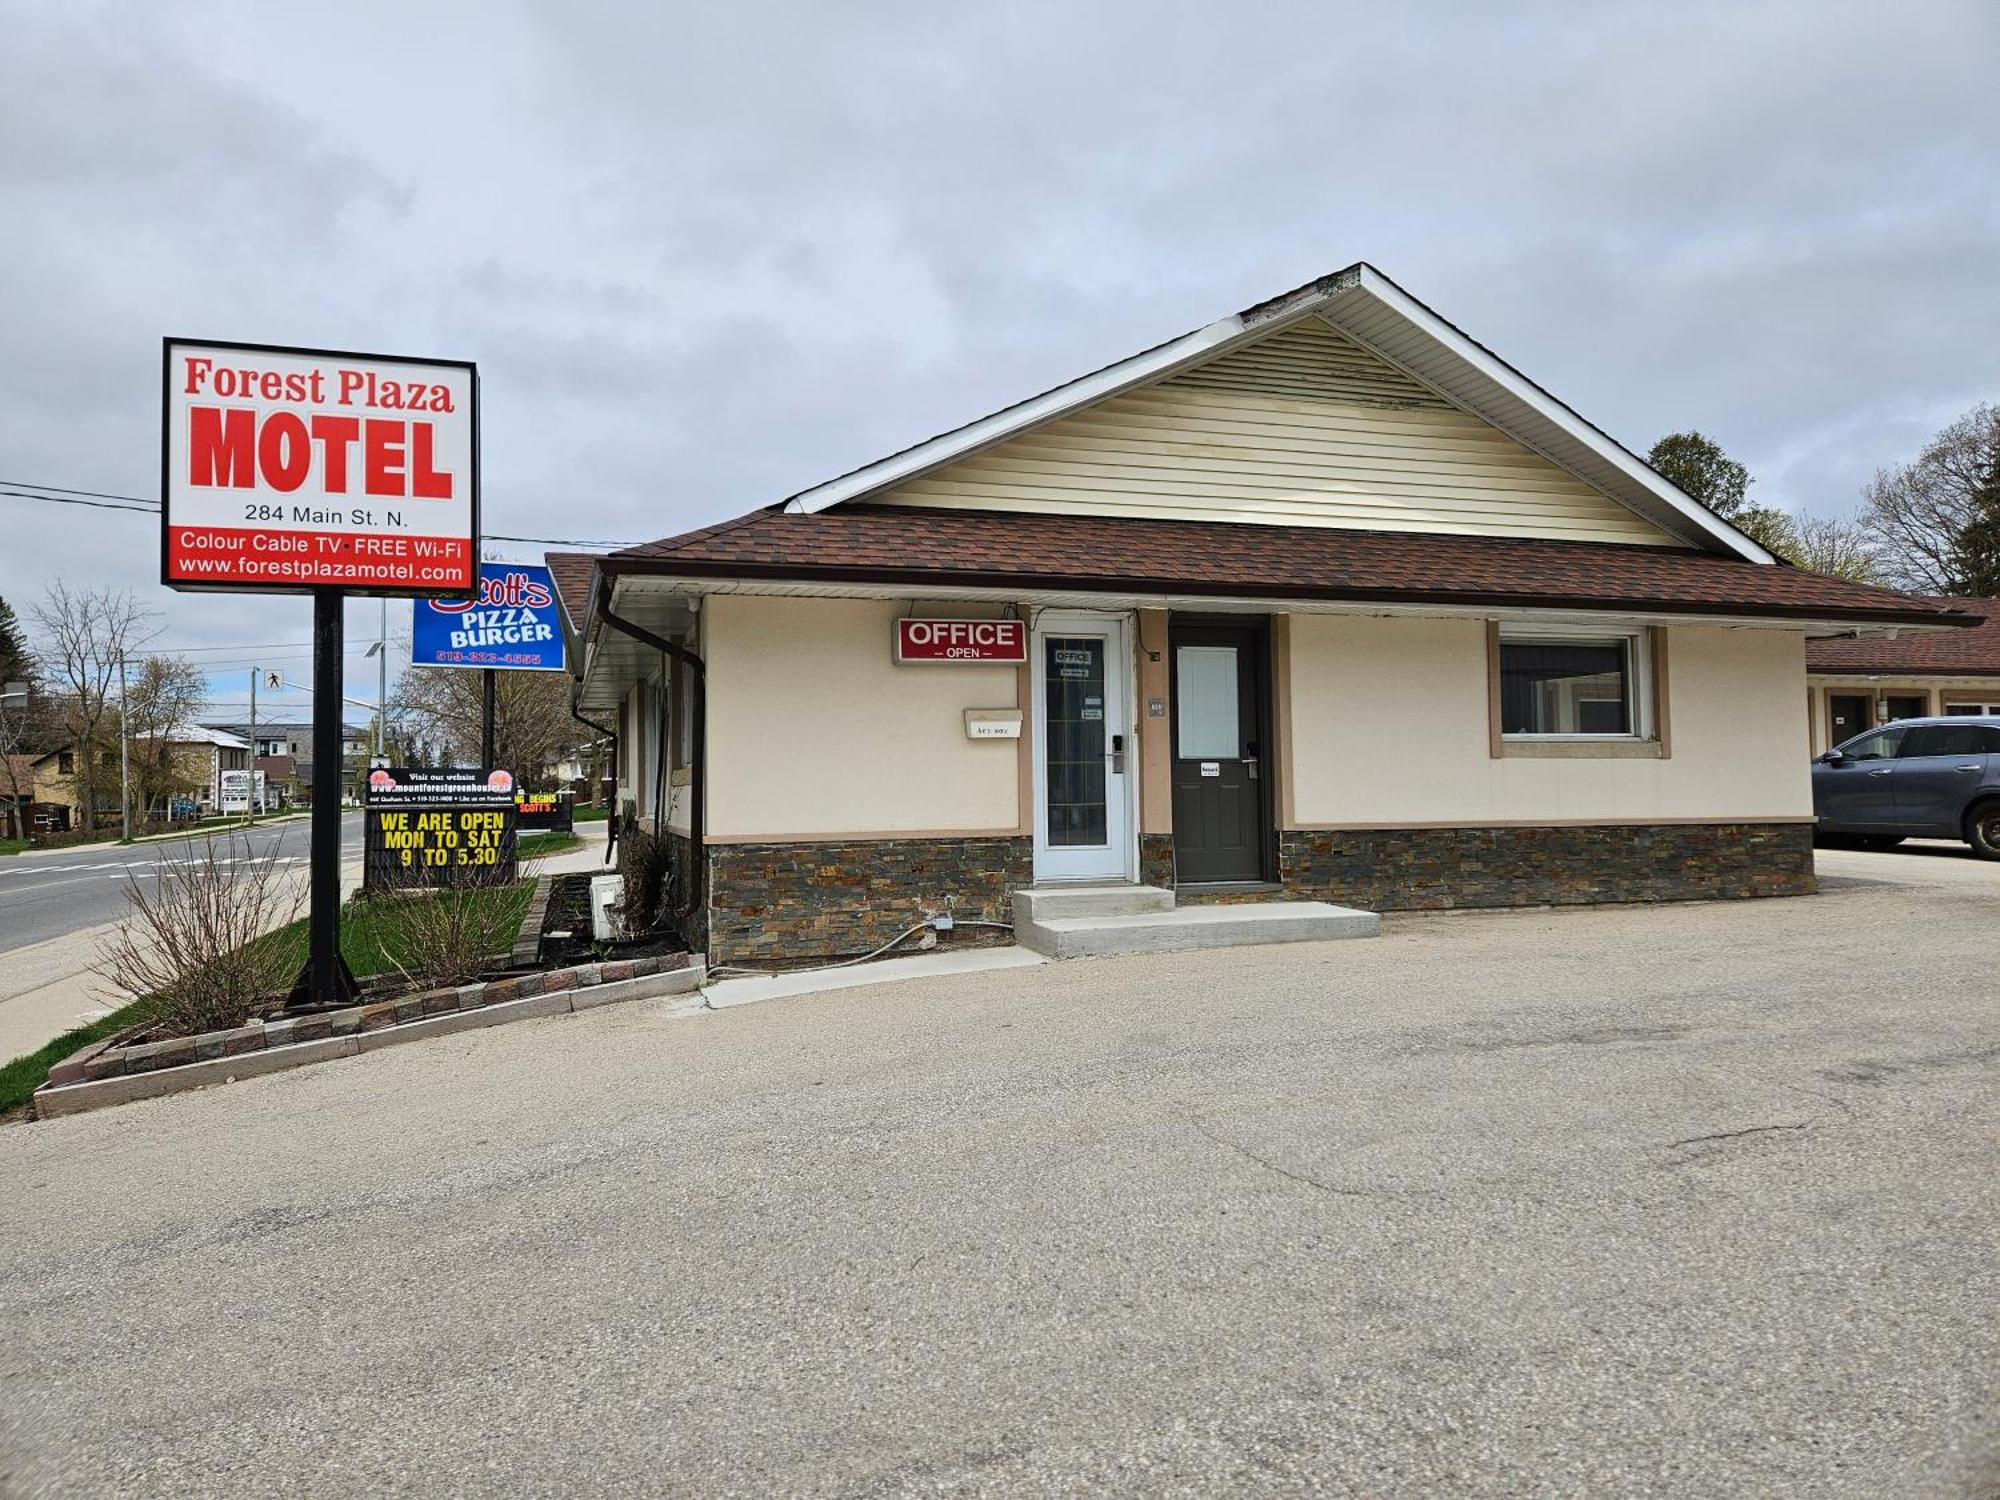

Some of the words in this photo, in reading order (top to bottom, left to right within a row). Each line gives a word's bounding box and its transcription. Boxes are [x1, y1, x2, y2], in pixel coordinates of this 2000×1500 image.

[184, 357, 325, 404] Forest
[337, 369, 455, 414] Plaza
[189, 406, 453, 500] MOTEL
[244, 504, 284, 522] 284
[293, 508, 343, 525] Main
[351, 510, 378, 527] St.
[387, 511, 409, 527] N.
[180, 532, 246, 551] Colour
[252, 534, 309, 553] Cable
[315, 537, 342, 554] TV
[354, 539, 407, 557] FREE
[414, 541, 462, 558] Wi-Fi
[179, 557, 462, 581] www.forestplazamotel.com
[461, 607, 538, 630] PIZZA
[450, 623, 553, 649] BURGER
[908, 622, 1015, 646] OFFICE
[946, 647, 980, 658] OPEN
[1057, 652, 1089, 662] OFFICE
[408, 772, 428, 781] Visit
[446, 772, 476, 781] website
[380, 813, 409, 831] WE
[417, 813, 452, 831] ARE
[460, 812, 505, 830] OPEN
[385, 831, 424, 849] MON
[436, 831, 458, 848] TO
[468, 830, 502, 848] SAT
[401, 849, 413, 867] 9
[424, 849, 448, 866] TO
[457, 847, 497, 866] 5.30
